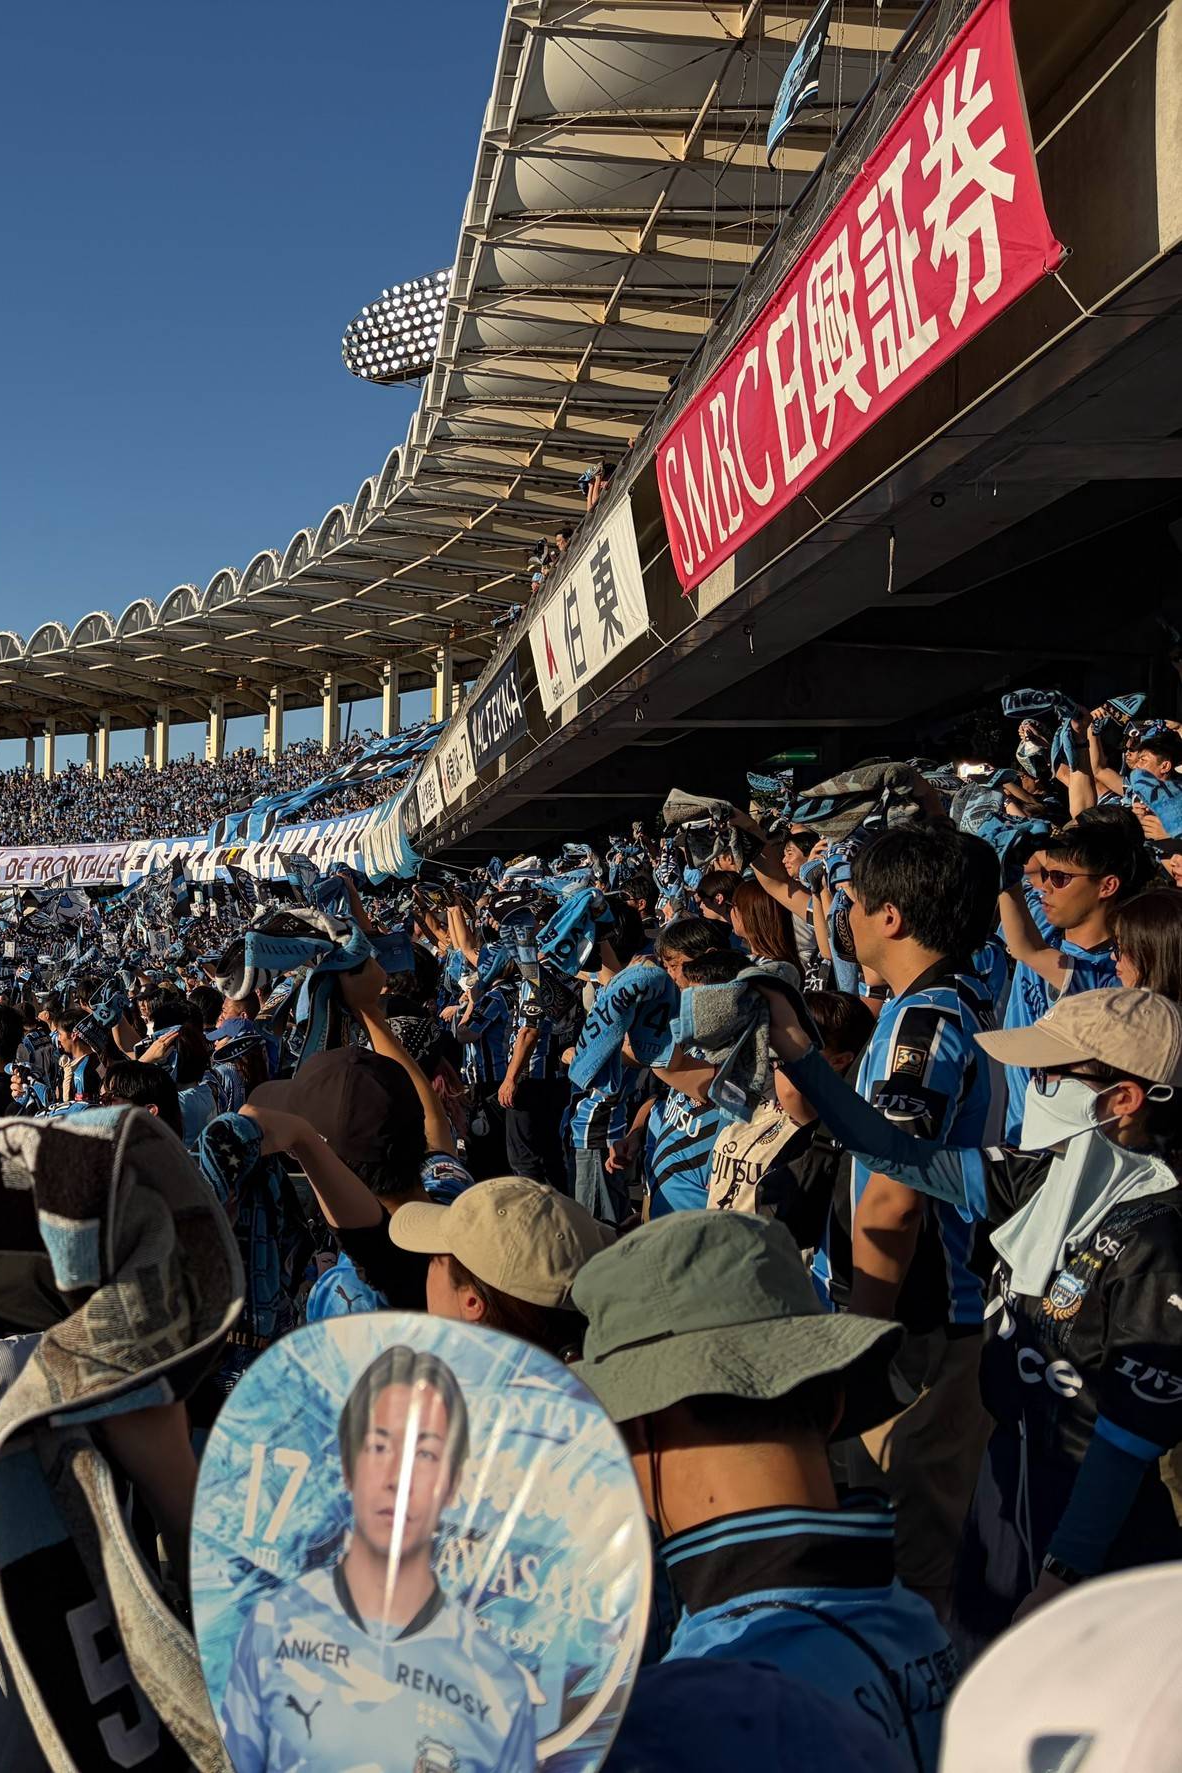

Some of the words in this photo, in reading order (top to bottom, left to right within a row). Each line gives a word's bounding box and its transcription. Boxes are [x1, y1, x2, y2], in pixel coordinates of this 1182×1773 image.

[664, 47, 1017, 577] SMBC日興証券
[563, 537, 626, 685] 伯東
[5, 857, 30, 881] DE
[31, 853, 123, 881] FRONTALE
[664, 1096, 702, 1138] UJITSU
[873, 1093, 927, 1113] エバラ
[712, 1149, 763, 1185] UJITSU
[242, 1443, 311, 1544] 17
[276, 1639, 351, 1668] ANKER
[396, 1664, 491, 1721] RENOSY
